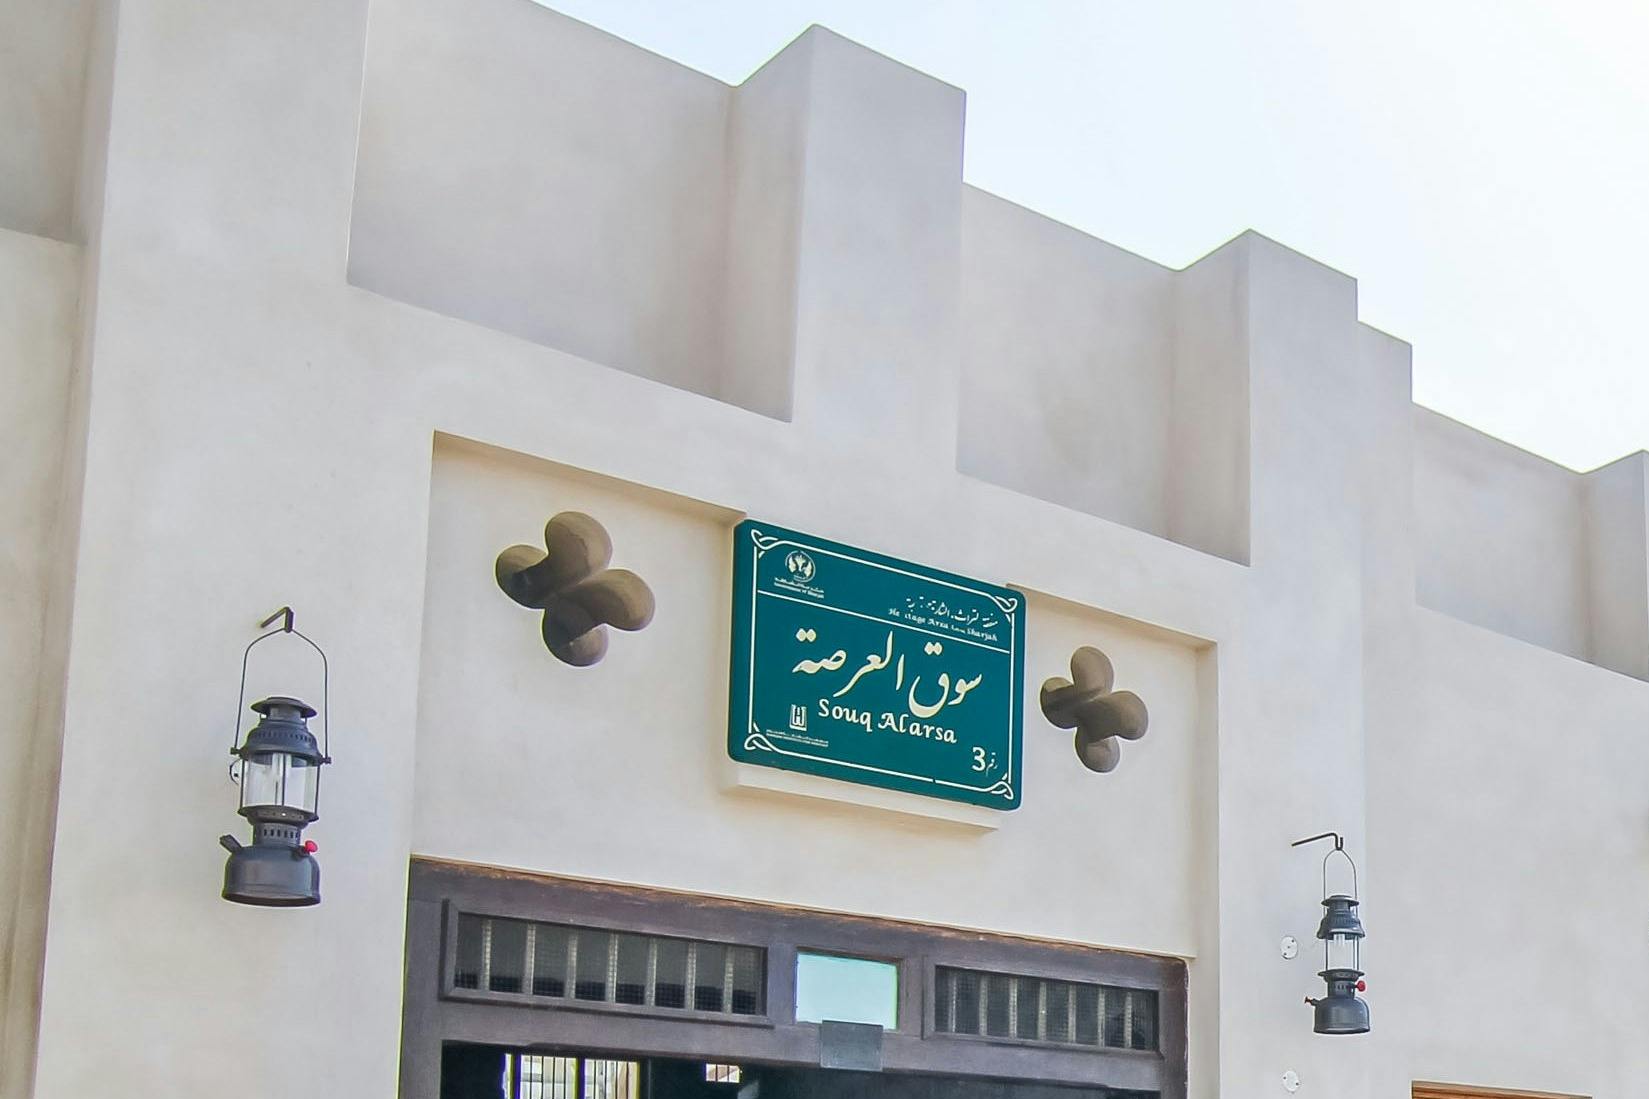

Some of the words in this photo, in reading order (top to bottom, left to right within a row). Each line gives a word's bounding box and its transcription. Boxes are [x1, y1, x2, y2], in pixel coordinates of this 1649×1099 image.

[791, 628, 905, 698] العرصة
[908, 641, 983, 719] سوق
[818, 698, 873, 733] Souq
[877, 711, 958, 744] Alarsa
[971, 746, 987, 772] 3
